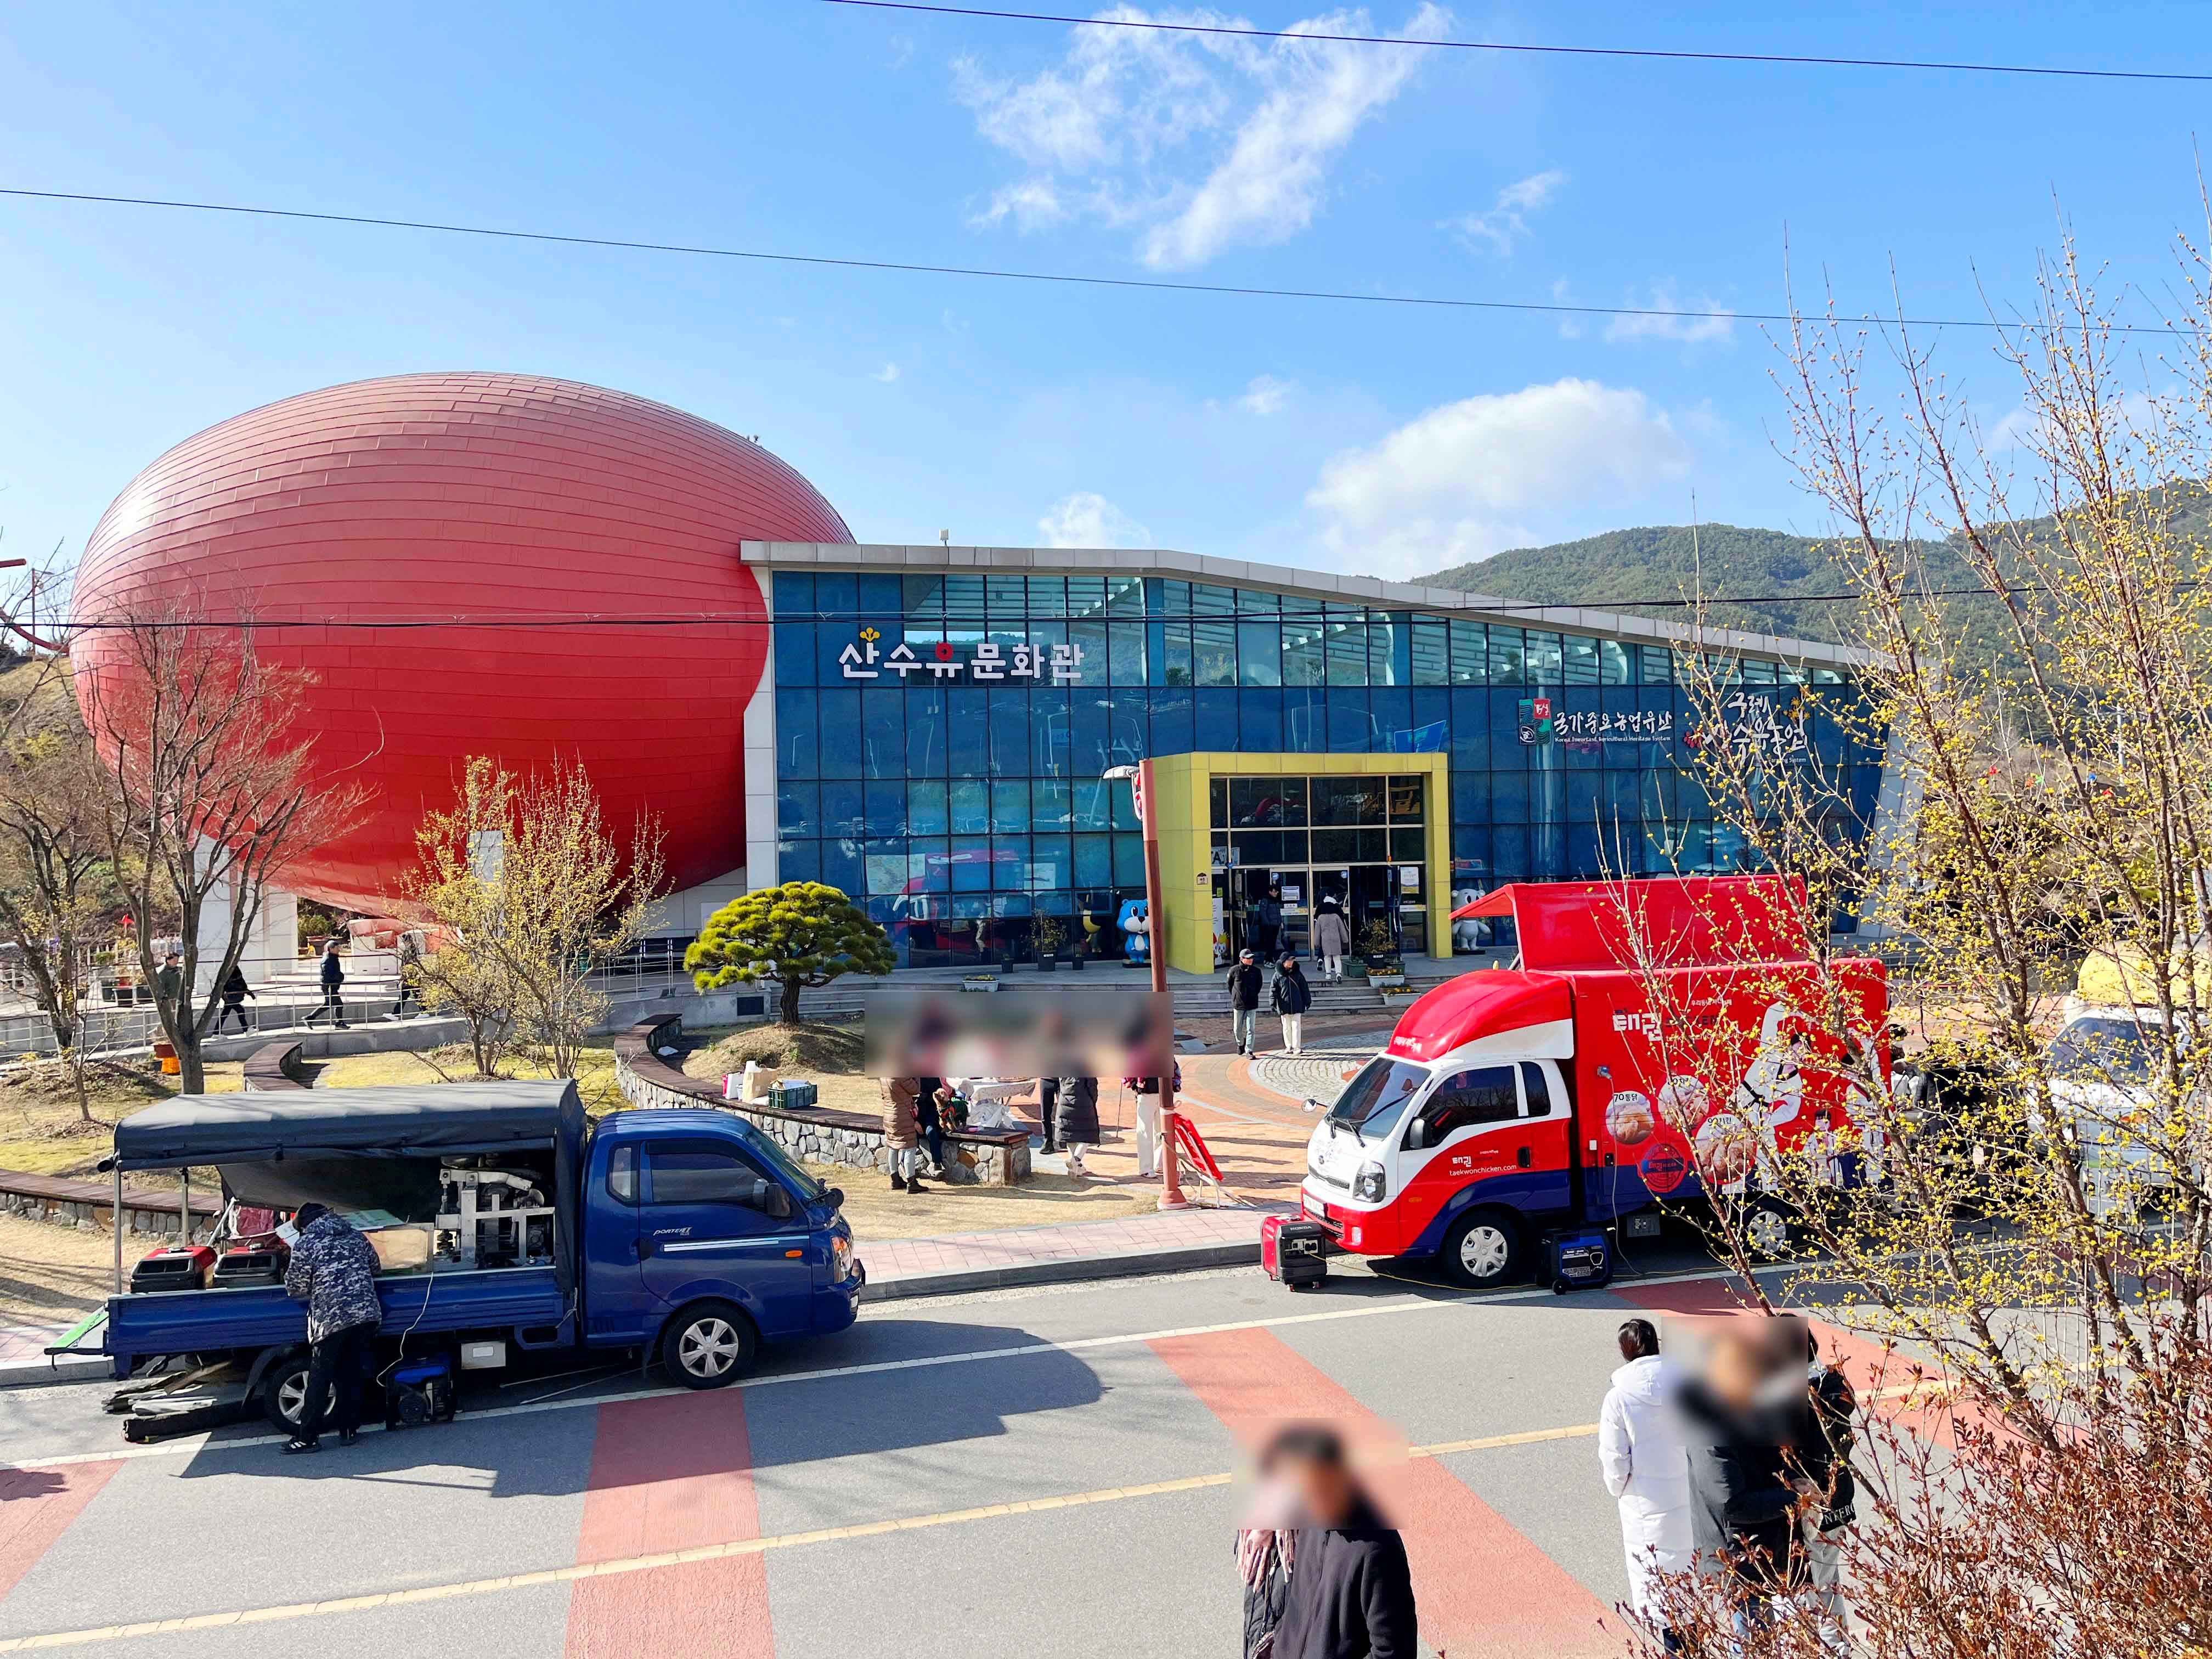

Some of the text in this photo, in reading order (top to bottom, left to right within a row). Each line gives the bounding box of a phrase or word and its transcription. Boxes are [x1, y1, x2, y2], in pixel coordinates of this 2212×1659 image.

[838, 641, 1085, 679] 산수유문화관
[1727, 692, 1770, 718] 구례
[1449, 1165, 1517, 1176] taekwonchicken.com
